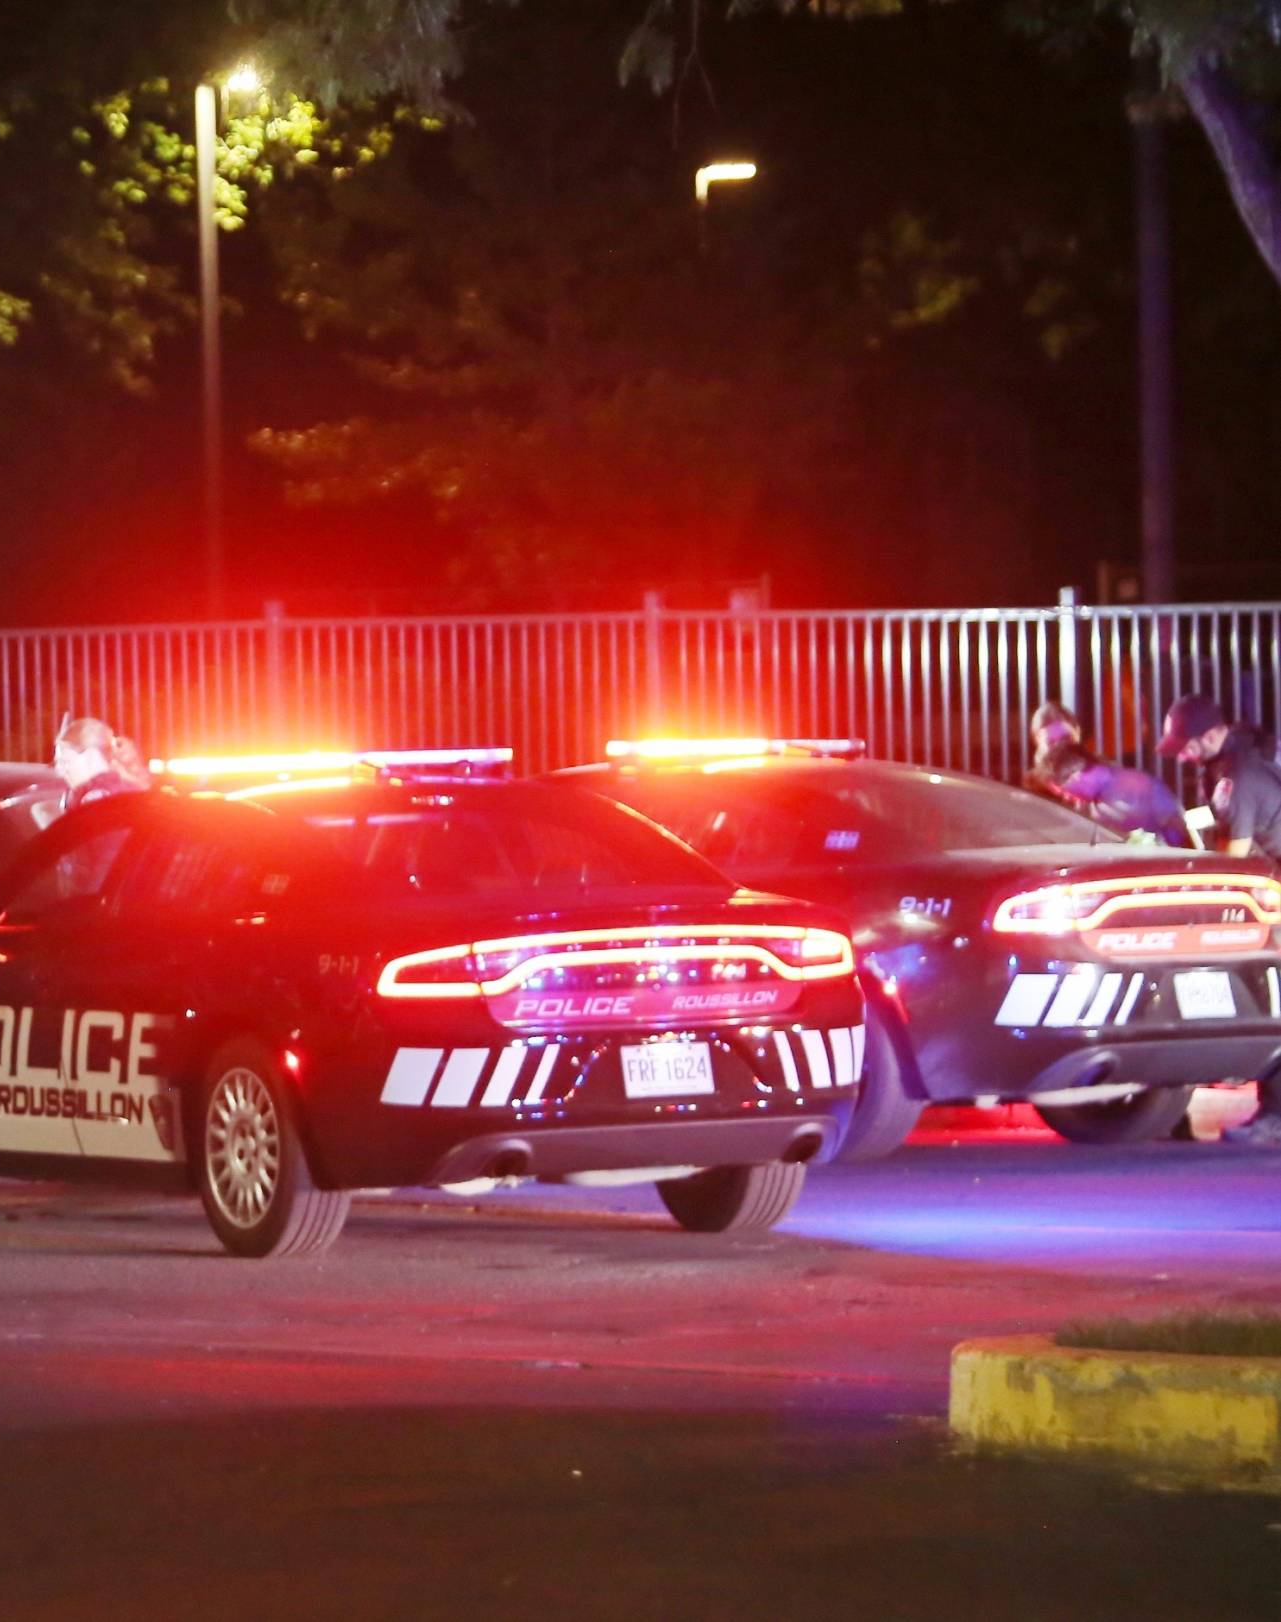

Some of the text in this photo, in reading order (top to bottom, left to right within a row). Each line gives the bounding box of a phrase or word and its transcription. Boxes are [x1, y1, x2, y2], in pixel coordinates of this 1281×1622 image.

[1096, 931, 1177, 950] POLICE
[513, 989, 778, 1017] POLICE ROUSSILLON
[665, 1056, 708, 1081] 1624
